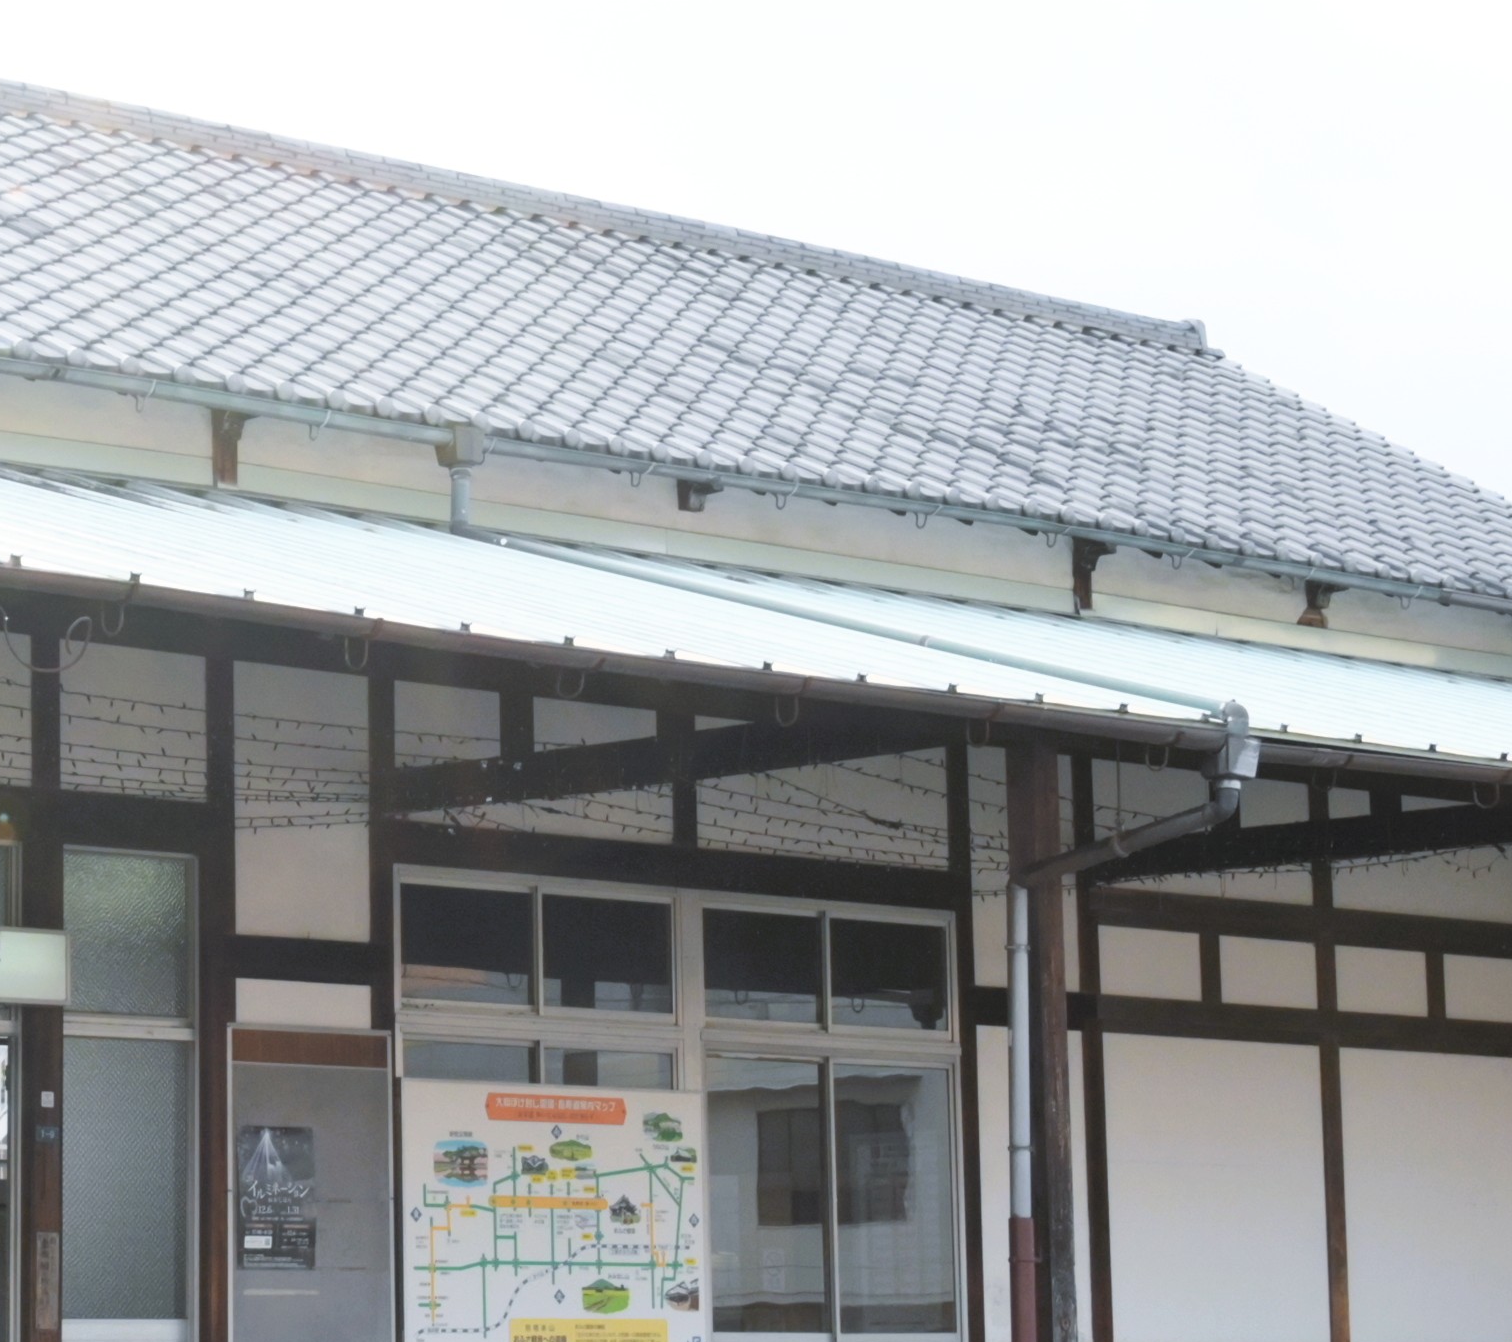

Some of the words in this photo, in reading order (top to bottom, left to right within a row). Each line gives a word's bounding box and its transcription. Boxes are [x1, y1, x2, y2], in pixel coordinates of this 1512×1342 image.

[247, 1180, 311, 1199] イルミネーション
